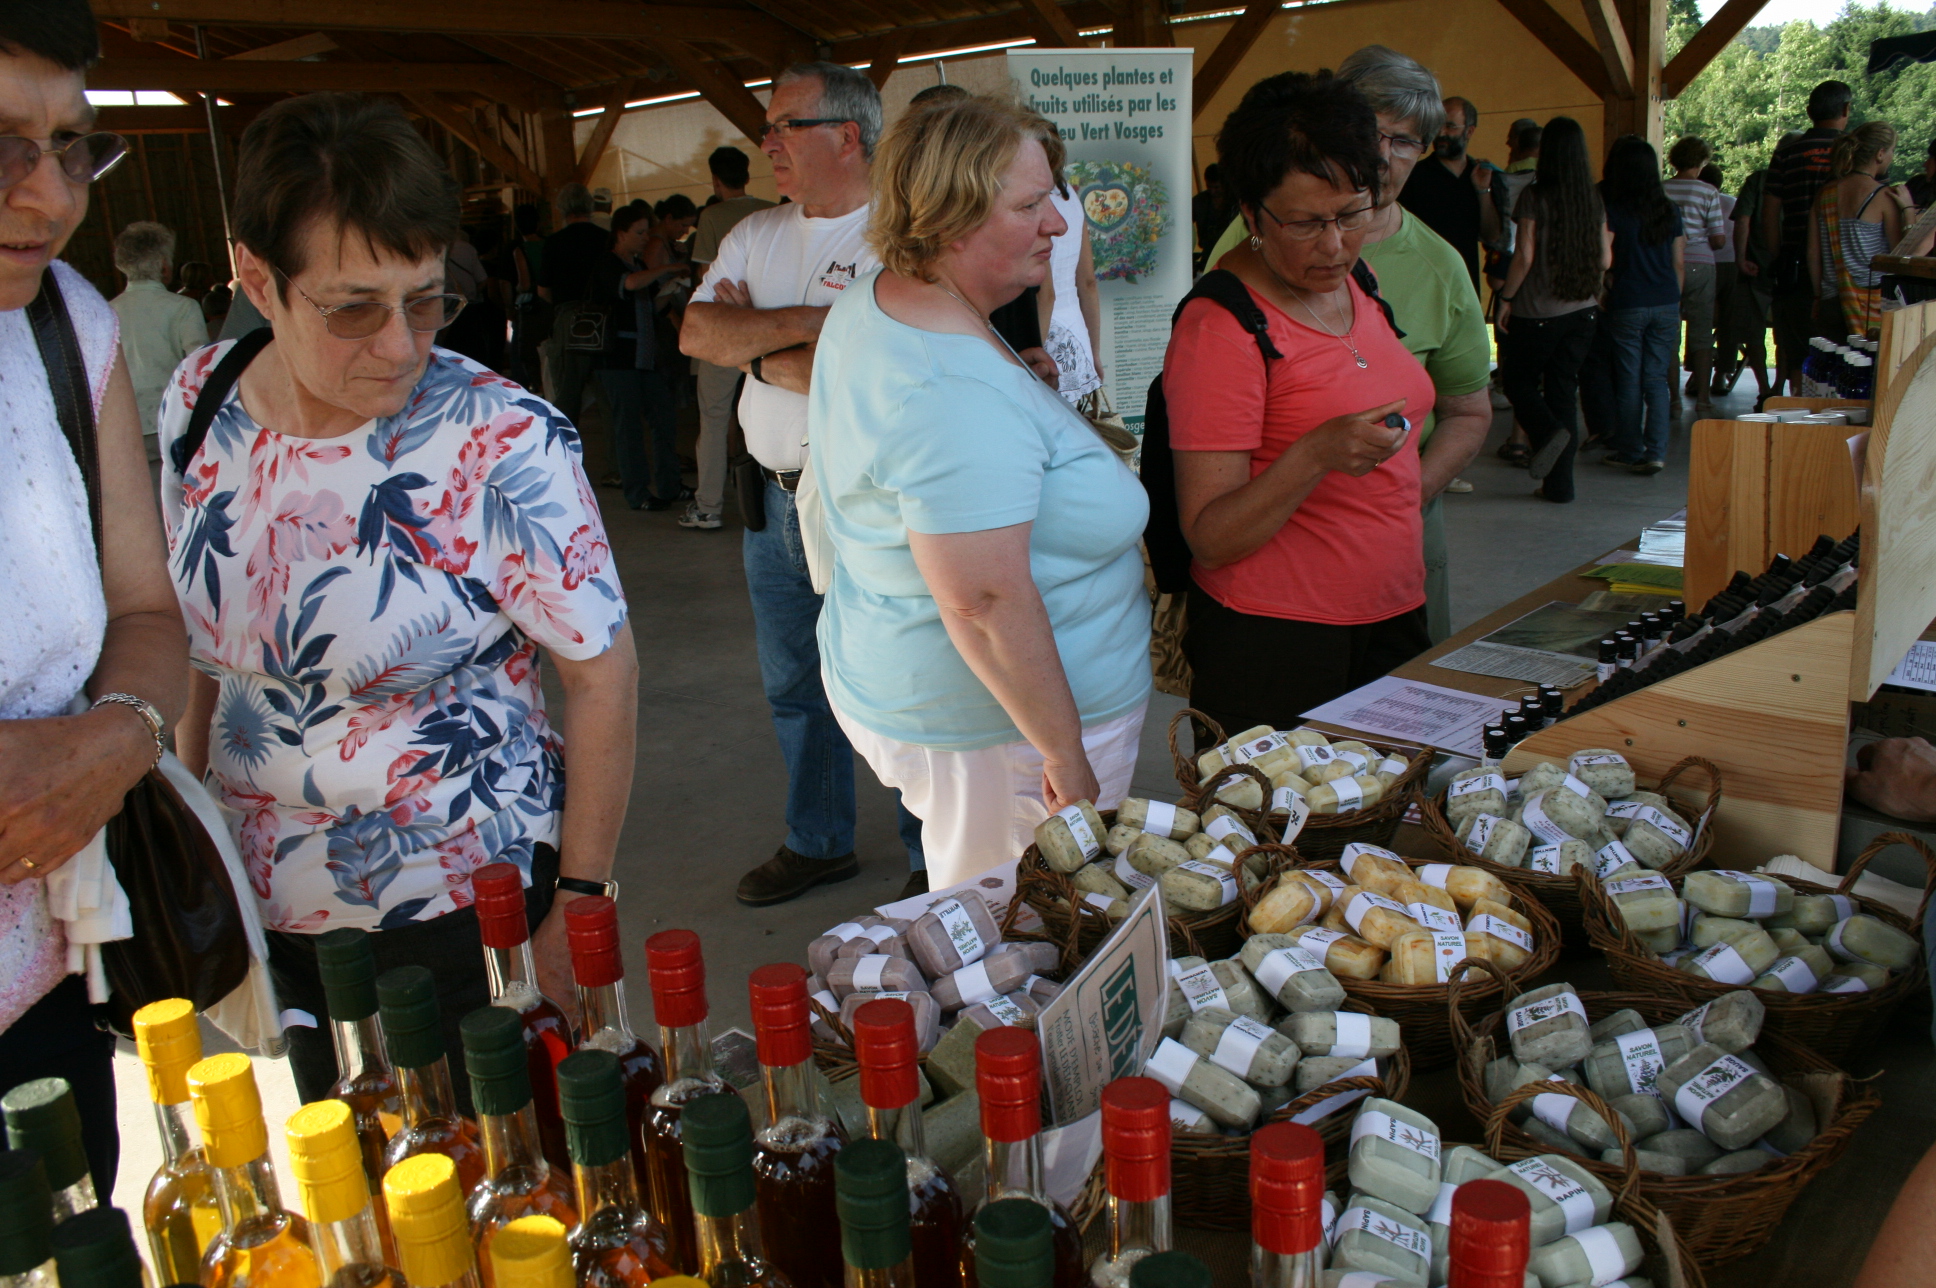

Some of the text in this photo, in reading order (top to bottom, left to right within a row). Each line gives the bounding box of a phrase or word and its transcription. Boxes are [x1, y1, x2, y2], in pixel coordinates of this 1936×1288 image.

[1031, 66, 1174, 91] Quelques plantes et
[1030, 92, 1176, 117] fruits utilisés par les
[1080, 122, 1110, 140] Vert
[1114, 121, 1163, 144] Vosges
[1124, 422, 1144, 433] osge
[1070, 812, 1080, 821] SAVON
[1070, 817, 1083, 827] NATUREL
[1608, 845, 1623, 864] MENTHE
[940, 903, 960, 918] MYRTILLE
[1420, 904, 1429, 924] CALENDULA
[958, 937, 978, 951] NATUREL
[1303, 935, 1329, 943] CALENDULA
[962, 944, 978, 956] SAVON
[1777, 961, 1794, 974] SAVON
[1179, 969, 1208, 982] VERVEINE
[1192, 987, 1220, 1000] NATUREL
[1196, 993, 1218, 1005] SAVON
[989, 1000, 1010, 1009] NATUREL
[1561, 996, 1569, 1009] SAVON
[1516, 1012, 1524, 1027] SAUGE
[1055, 1016, 1064, 1048] Frotter
[1233, 1024, 1262, 1040] VERVEINE
[1626, 1050, 1657, 1060] NATUREL
[1629, 1043, 1653, 1053] SAVON
[1063, 1009, 1075, 1046] MODE
[1070, 1047, 1083, 1106] D'EMPLOI
[1725, 1056, 1749, 1073] SAUGE
[1049, 1050, 1062, 1089] pendant
[1686, 1086, 1705, 1100] SAVON
[1691, 1081, 1716, 1098] NATUREL
[1515, 1158, 1535, 1168] SAVON
[1518, 1162, 1543, 1174] NATUREL
[1556, 1186, 1585, 1202] SAPIN
[1361, 1209, 1371, 1230] SAPIN
[1411, 1231, 1419, 1250] NATUREL
